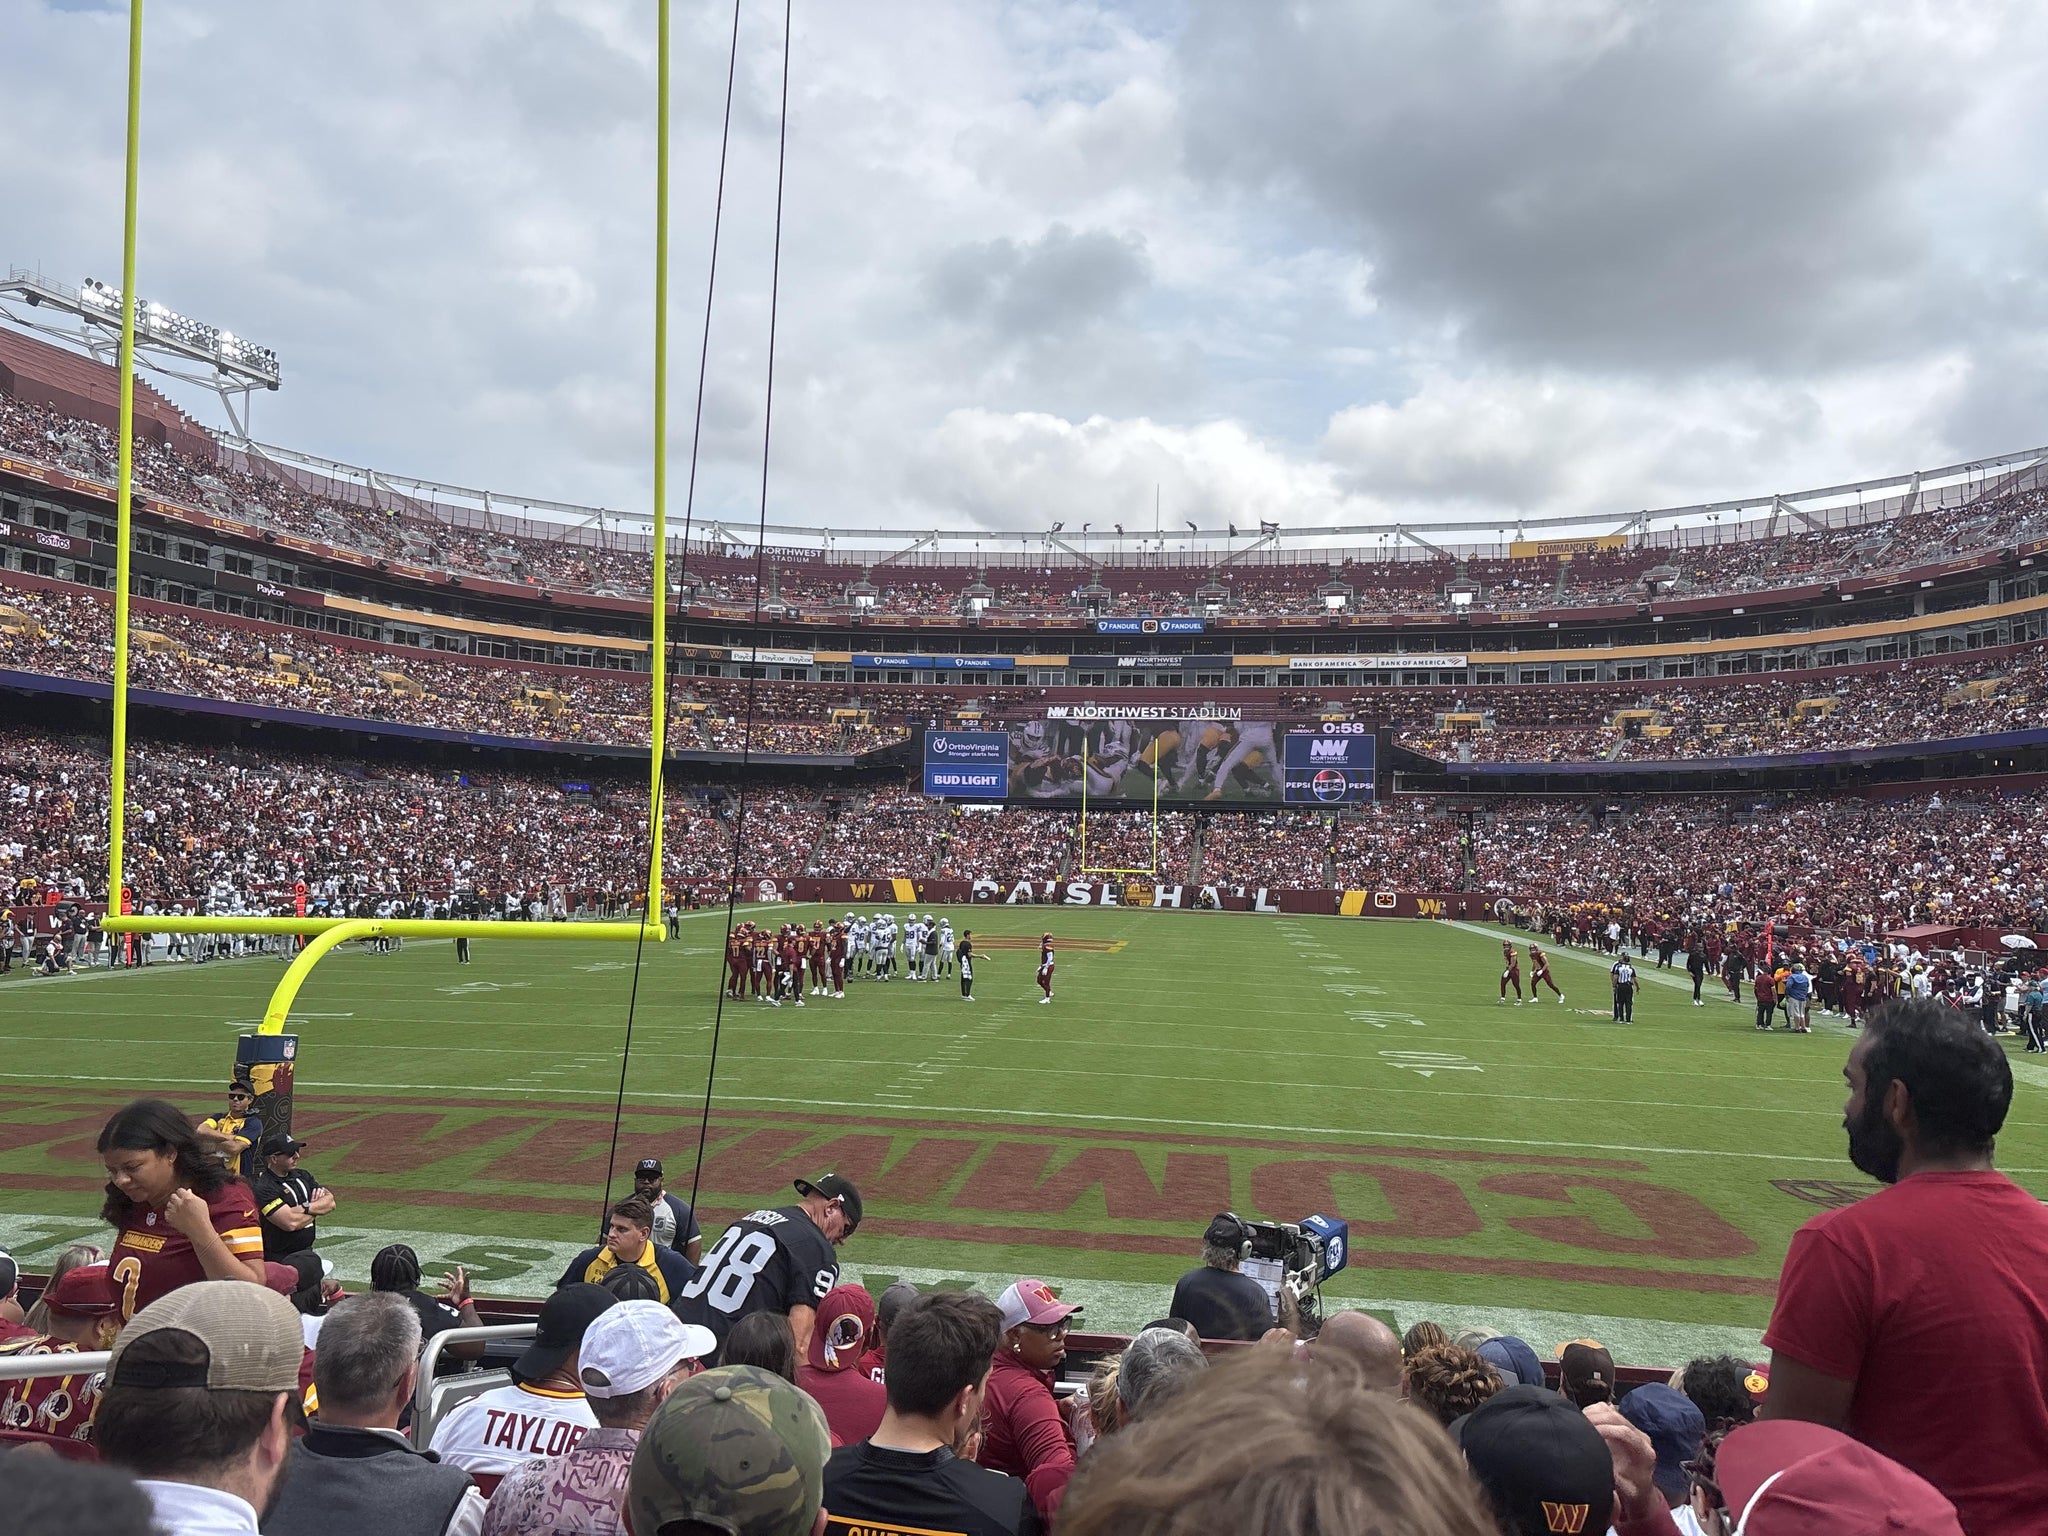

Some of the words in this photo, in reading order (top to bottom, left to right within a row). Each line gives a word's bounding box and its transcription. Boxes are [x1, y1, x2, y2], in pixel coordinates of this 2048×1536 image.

[758, 546, 822, 557] NORTHWEST
[771, 555, 810, 563] STADIUM
[256, 583, 286, 598] Paycor
[1143, 622, 1156, 631] 25
[1117, 658, 1136, 667] NW
[1047, 707, 1069, 717] NW
[1073, 707, 1167, 717] NORTHWEST
[1171, 707, 1241, 718] STADIUM
[1322, 723, 1364, 734] 0:58
[948, 743, 999, 752] OrthoVirginia
[1310, 740, 1349, 755] NW
[934, 775, 960, 785] BUD
[961, 776, 998, 785] LIGHT
[1378, 894, 1393, 906] 25
[681, 1226, 777, 1314] 98
[1541, 1501, 1590, 1534] W
